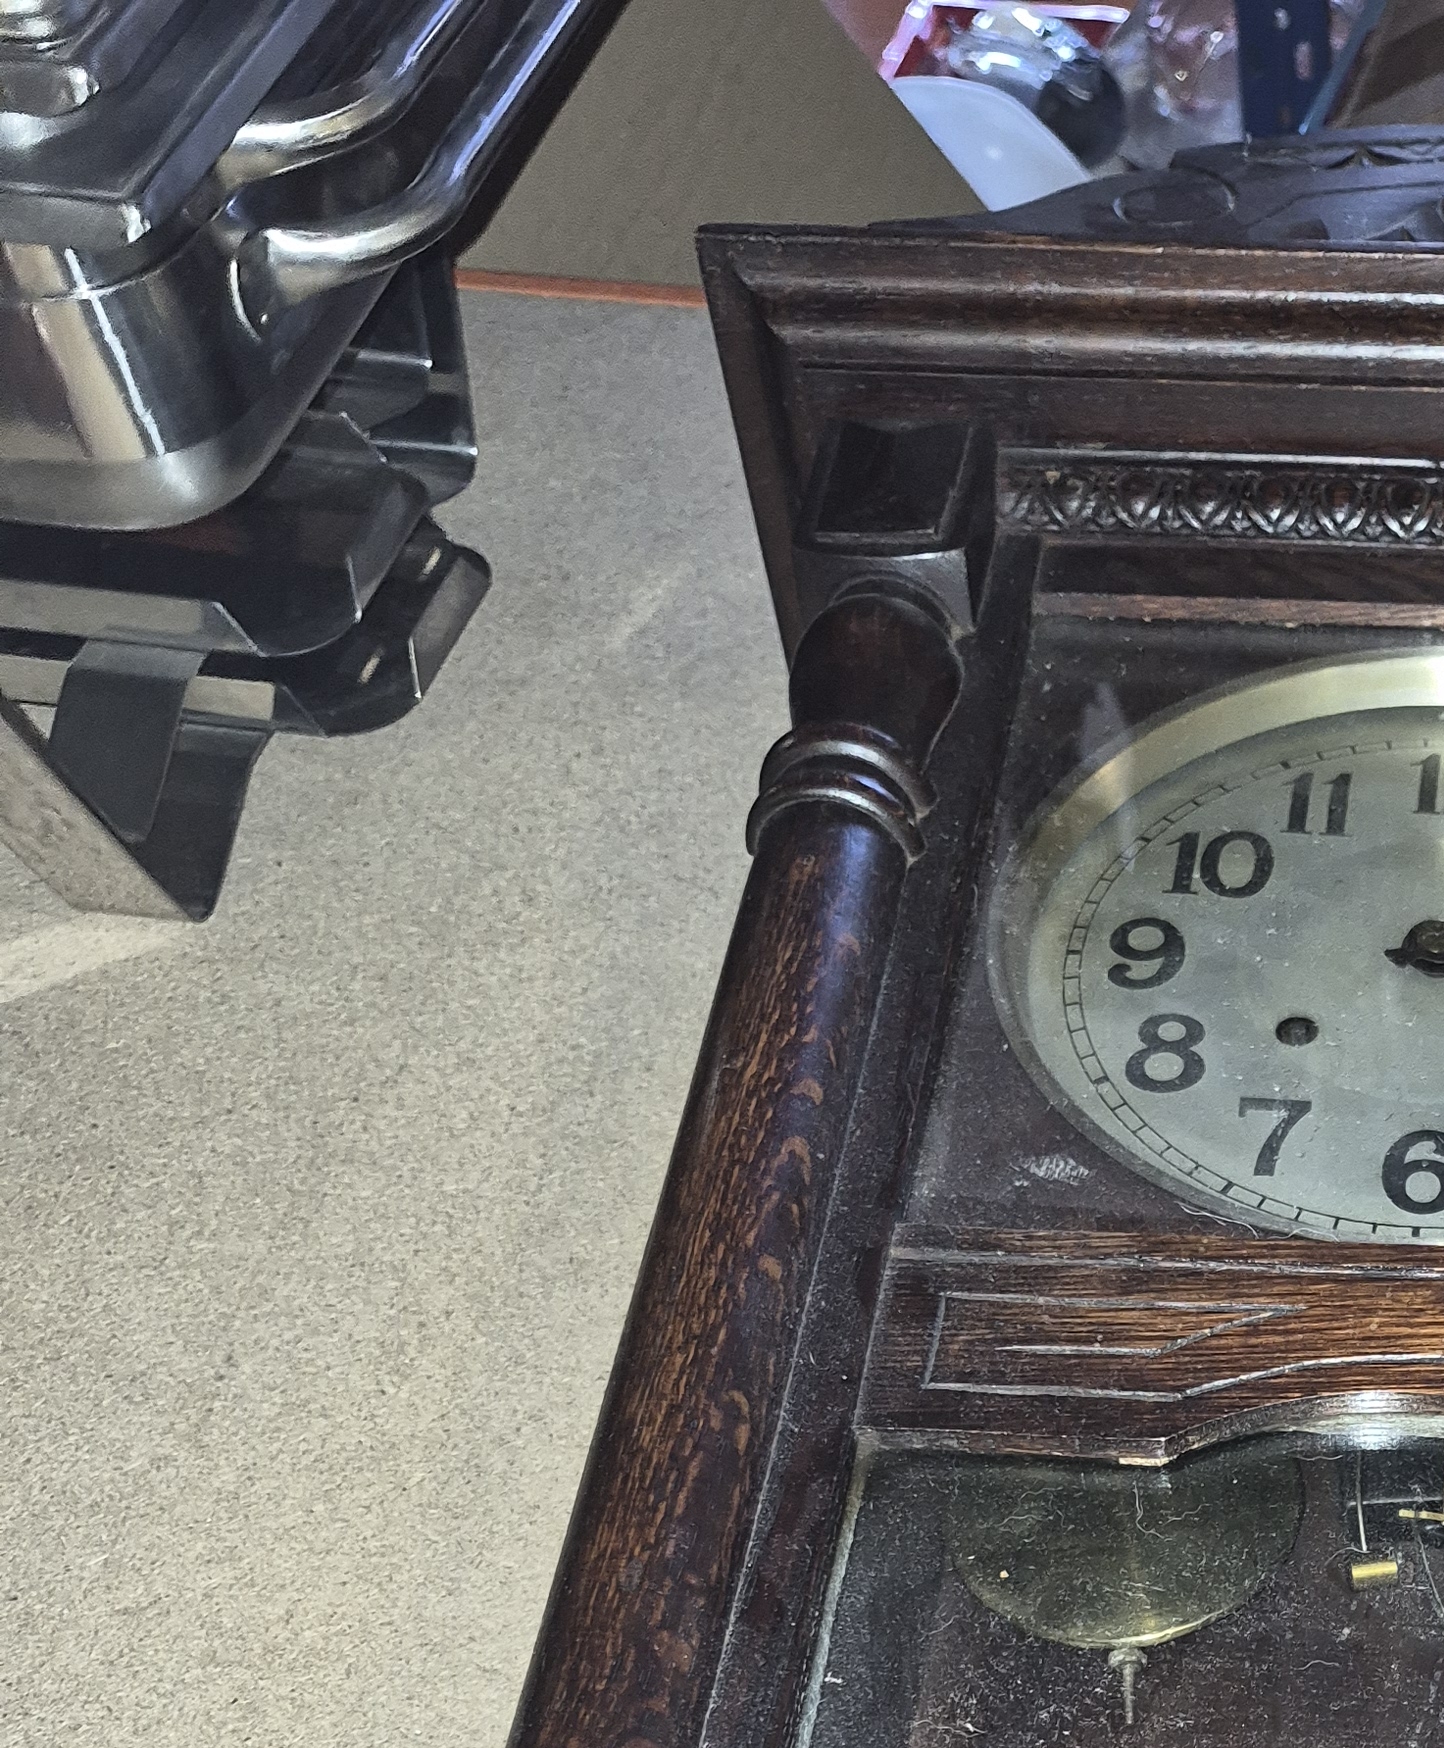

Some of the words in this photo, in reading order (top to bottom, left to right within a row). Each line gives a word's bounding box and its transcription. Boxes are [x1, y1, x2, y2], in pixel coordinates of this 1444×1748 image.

[1280, 772, 1353, 837] 11
[1162, 829, 1275, 899] 10
[1107, 915, 1186, 990] 9
[1124, 1012, 1206, 1094] 8
[1238, 1095, 1313, 1177] 7
